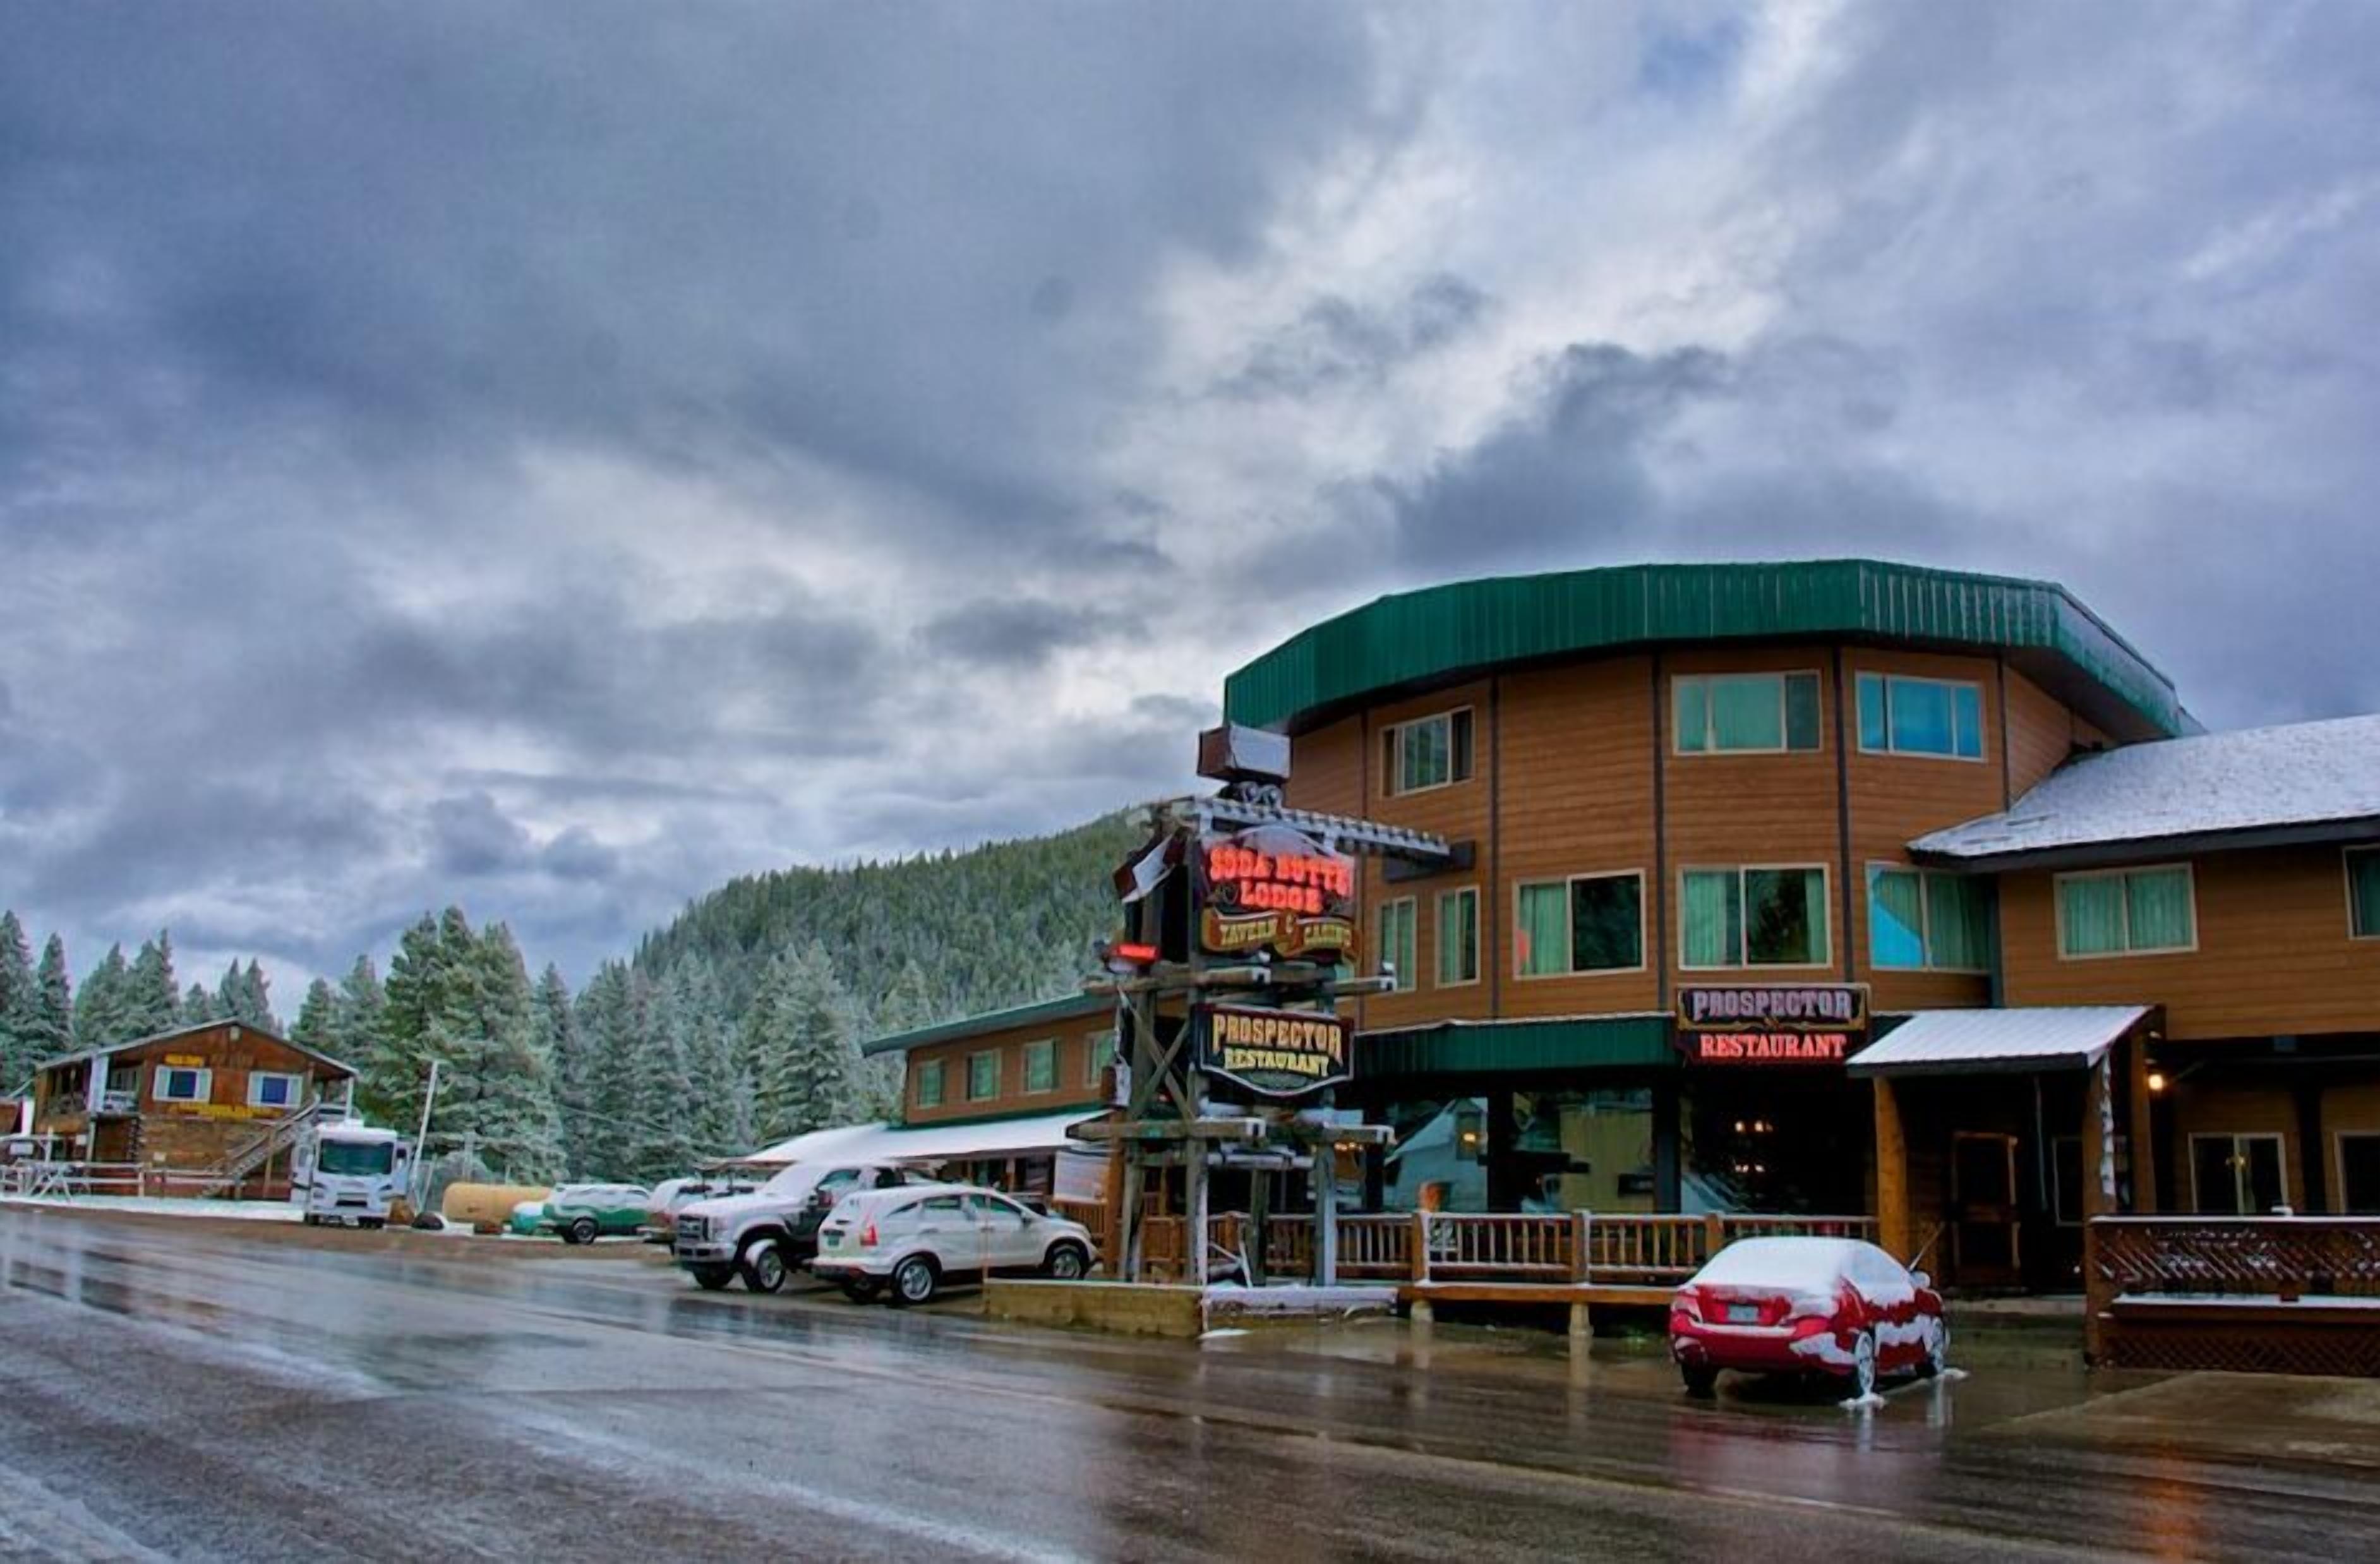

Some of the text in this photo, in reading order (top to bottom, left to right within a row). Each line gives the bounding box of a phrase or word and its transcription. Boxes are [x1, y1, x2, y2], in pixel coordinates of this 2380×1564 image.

[1693, 990, 1853, 1021] PROSPECTOR
[1212, 1013, 1343, 1068] PROSPECTOR
[1700, 1033, 1848, 1057] RESTAURANT
[1224, 1047, 1330, 1077] RESTAURANT
